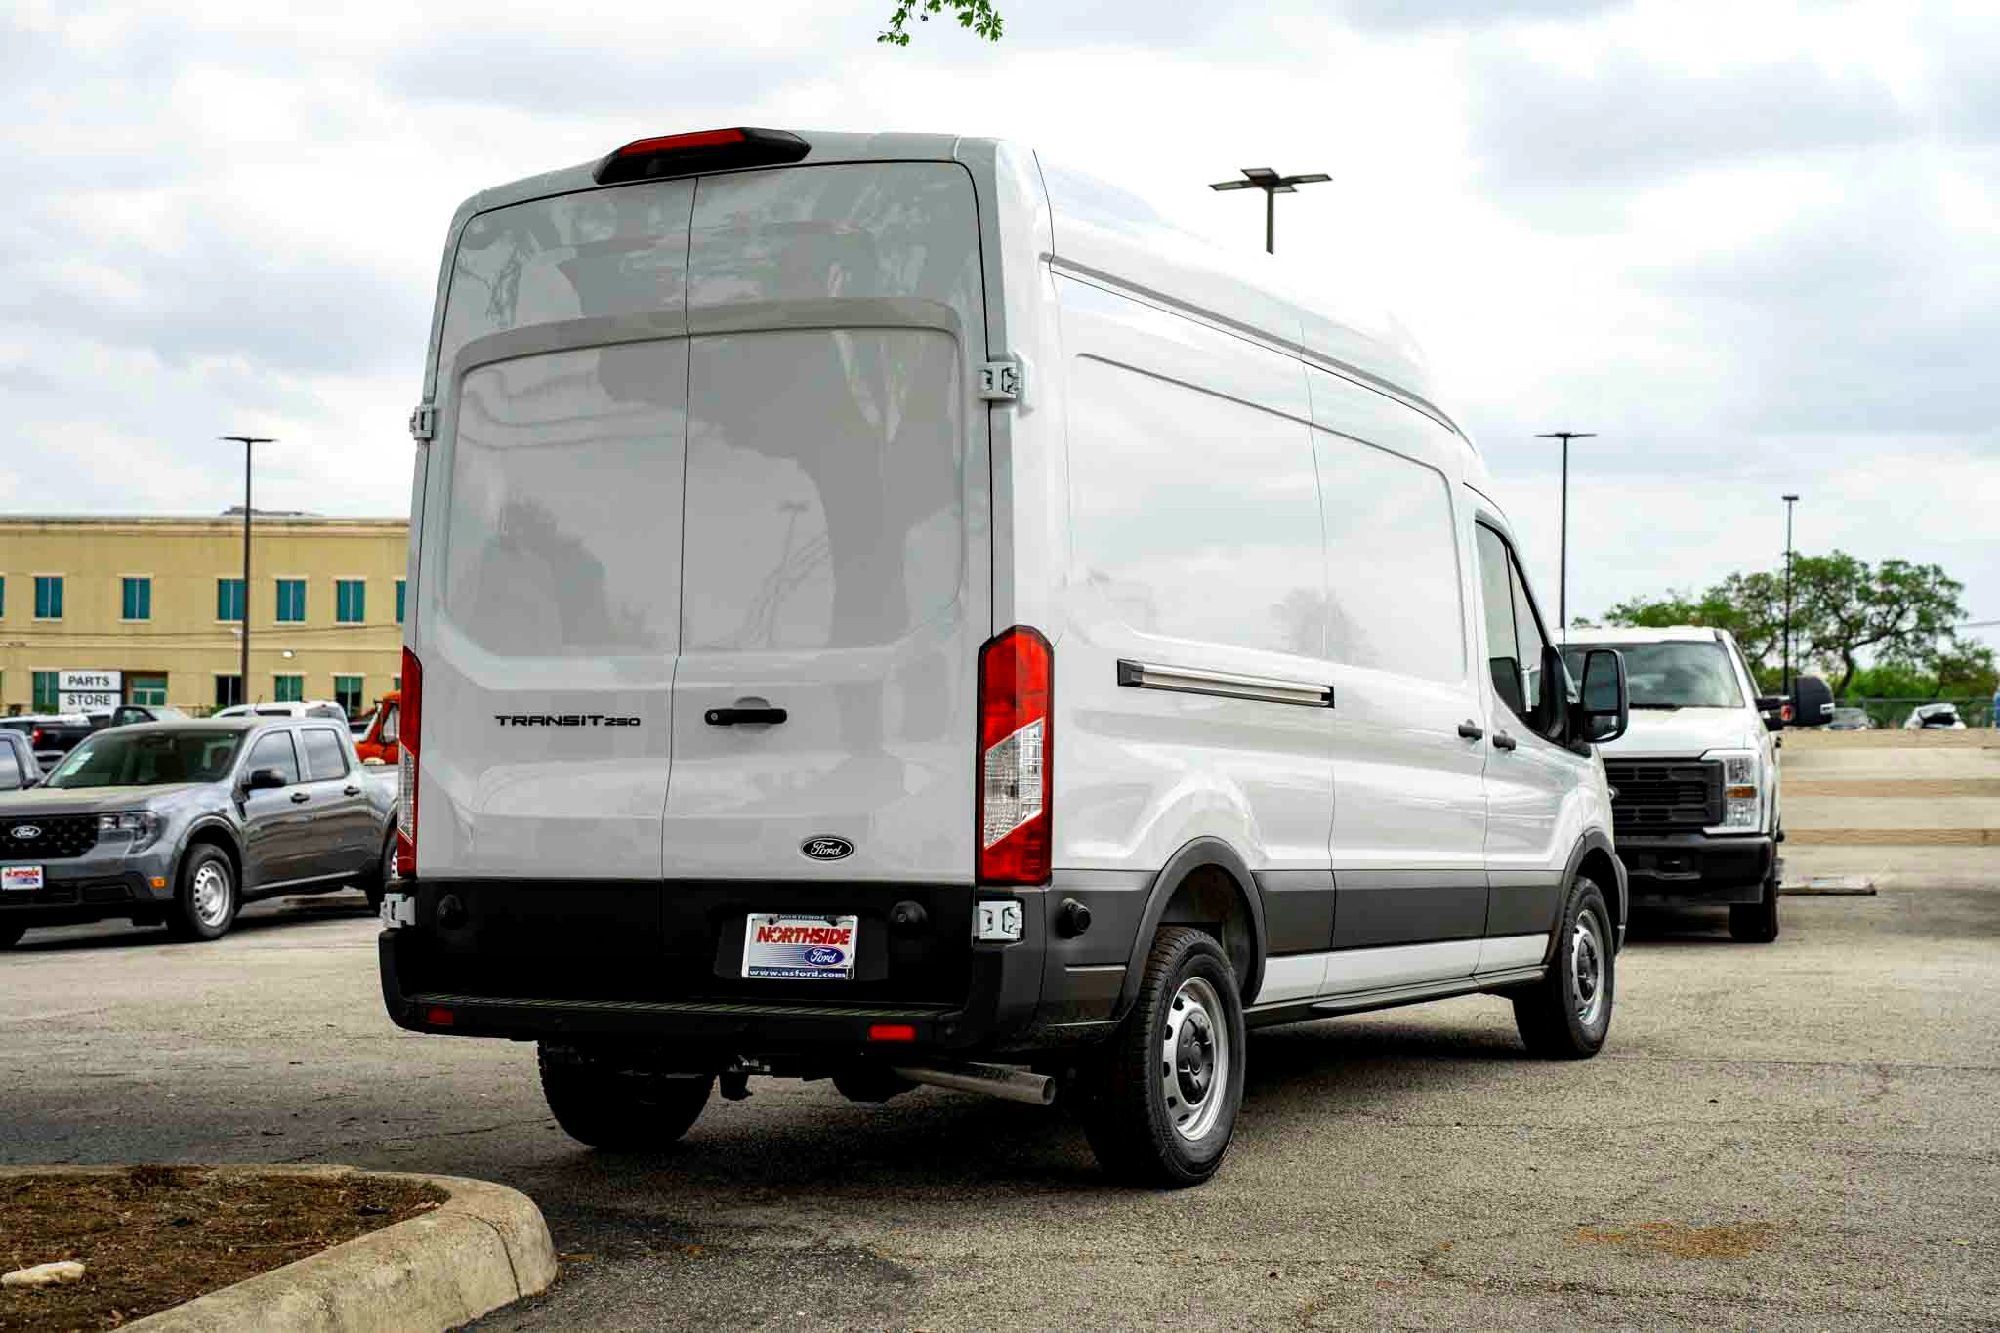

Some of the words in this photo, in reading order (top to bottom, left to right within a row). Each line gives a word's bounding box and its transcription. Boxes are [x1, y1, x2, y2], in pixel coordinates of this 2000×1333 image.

[68, 676, 110, 687] PARTS
[68, 694, 110, 705] STORE
[811, 841, 842, 855] Ford
[757, 926, 852, 945] NORTHSIDE
[811, 948, 837, 963] Ford
[749, 969, 846, 978] www.nsford.com
